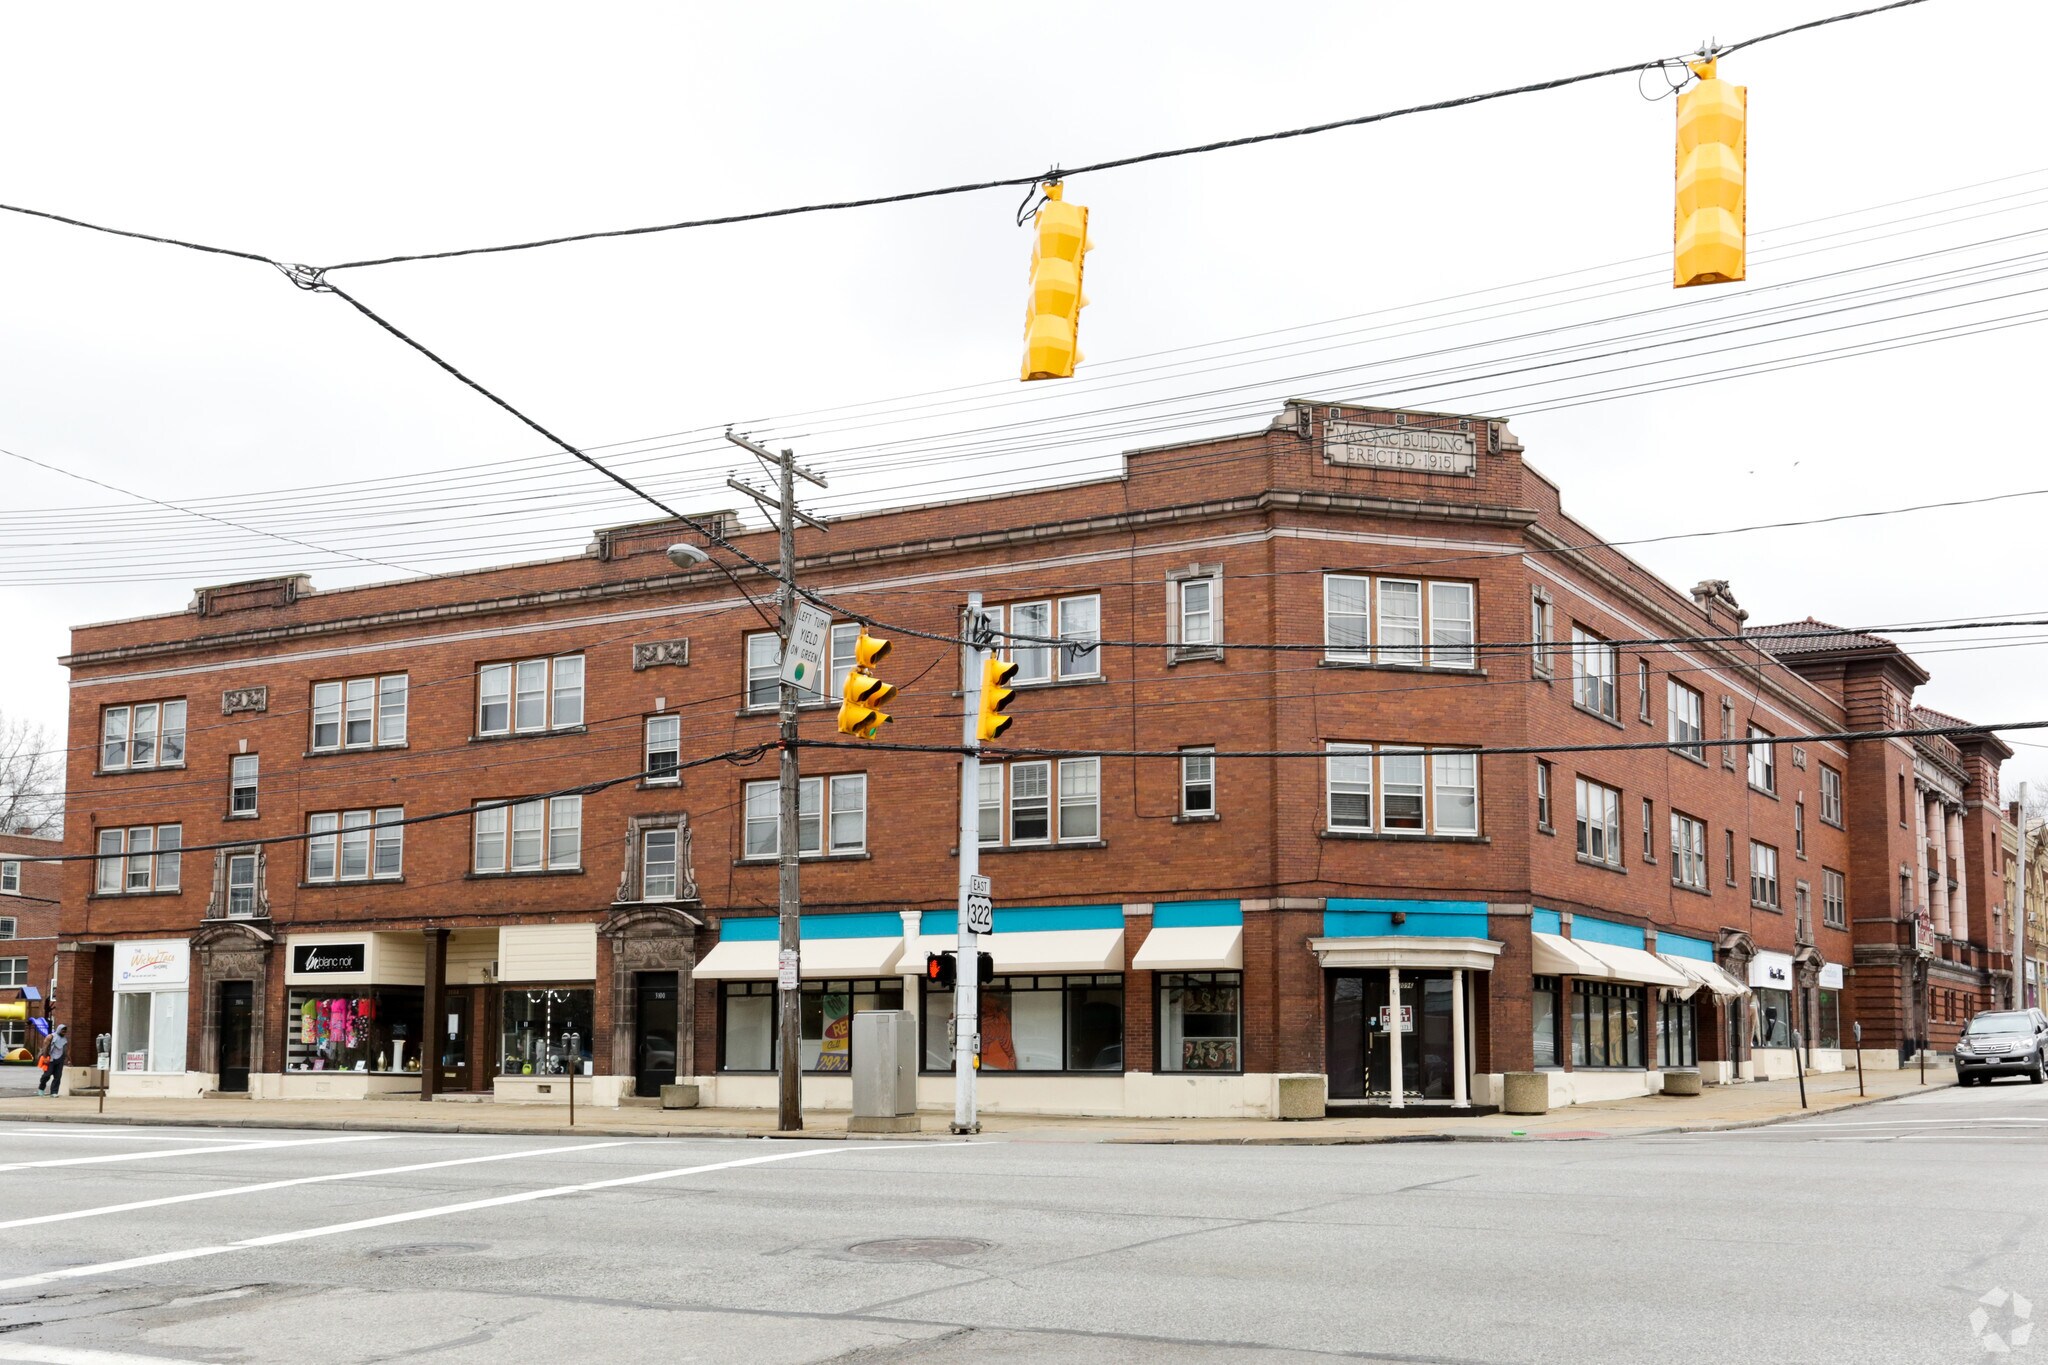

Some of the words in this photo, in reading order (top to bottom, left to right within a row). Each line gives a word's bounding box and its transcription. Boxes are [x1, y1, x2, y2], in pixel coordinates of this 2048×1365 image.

[1336, 428, 1399, 445] MASONIC
[1403, 434, 1463, 452] BUILDING
[1348, 447, 1415, 466] ERECTED
[1424, 455, 1451, 469] 1915
[799, 610, 812, 625] LEFT
[815, 616, 828, 630] TURN
[800, 628, 818, 646] YIELD
[790, 644, 799, 656] ON
[801, 649, 818, 662] GREEN
[973, 879, 987, 891] EAST
[970, 903, 990, 925] 322
[158, 951, 176, 963] Taco
[318, 956, 338, 967] blanc
[339, 955, 353, 966] noir
[827, 996, 846, 1015] FOR
[1382, 1014, 1410, 1022] RT
[827, 1040, 841, 1050] Call
[817, 1055, 848, 1071] 292-7
